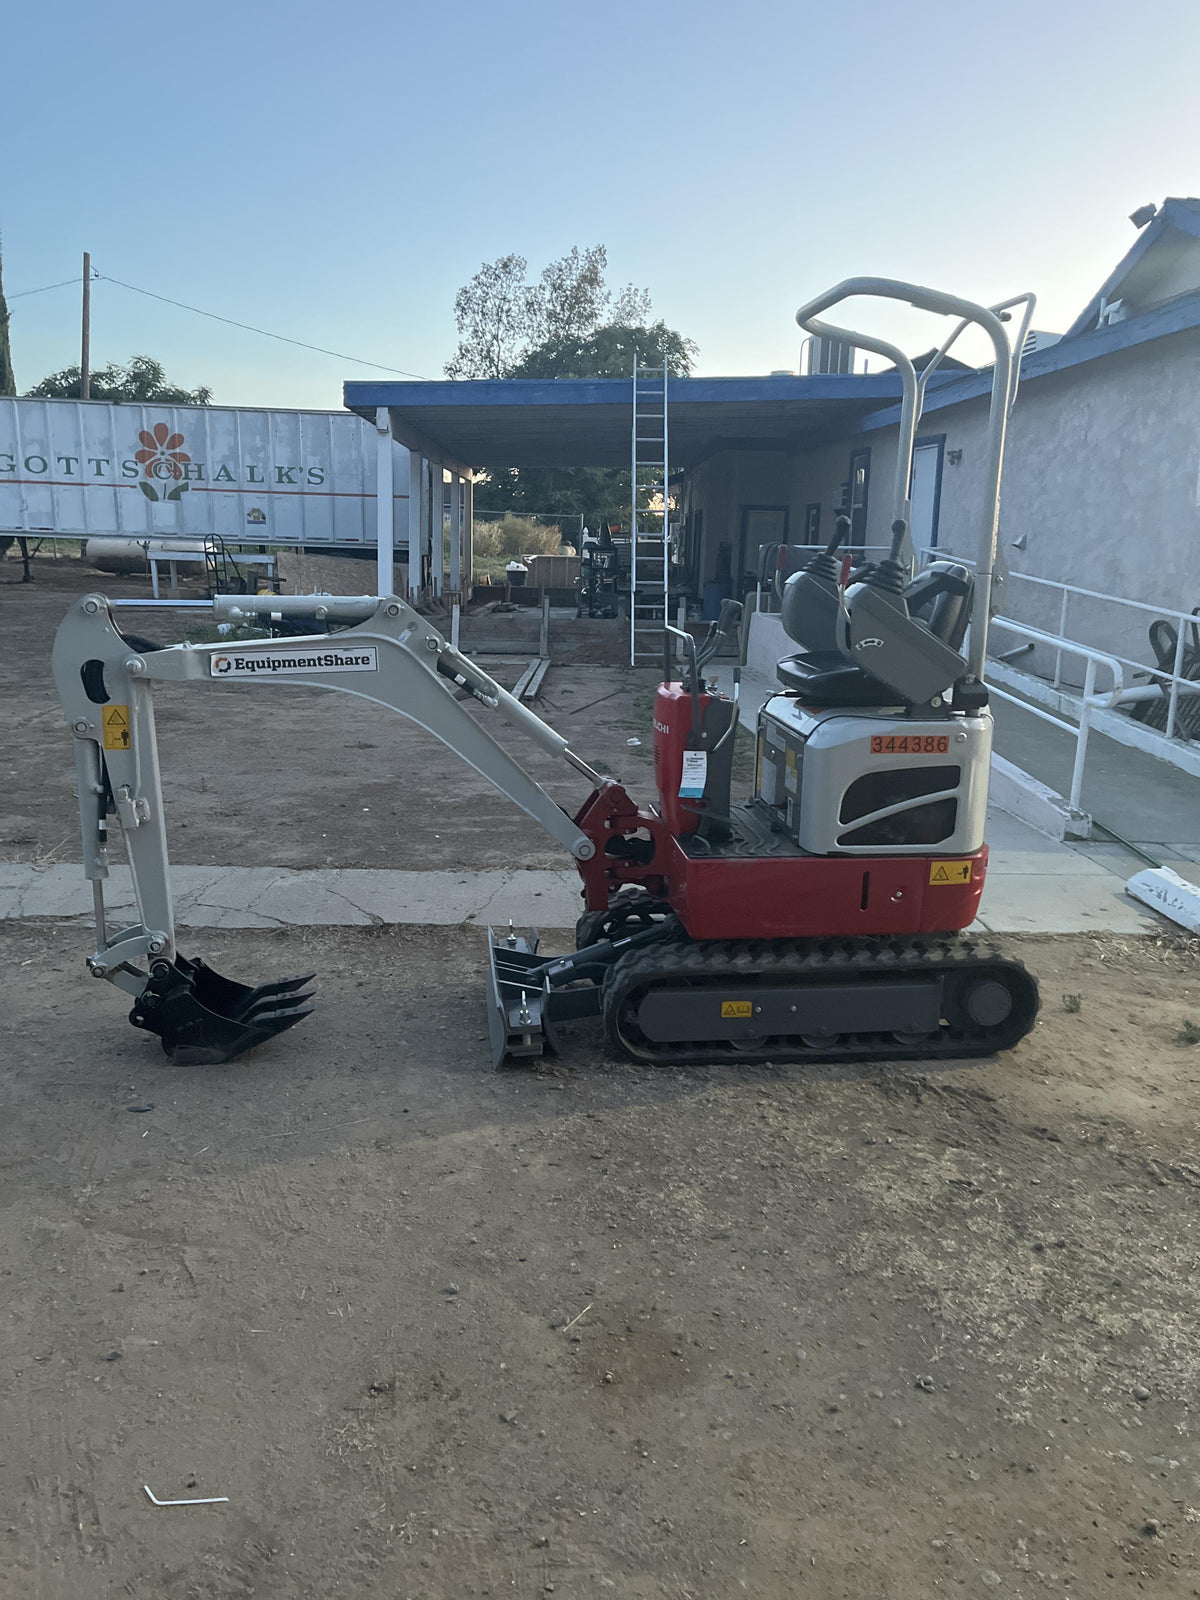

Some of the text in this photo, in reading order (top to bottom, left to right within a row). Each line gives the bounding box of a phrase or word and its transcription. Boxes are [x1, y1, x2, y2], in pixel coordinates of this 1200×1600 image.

[0, 454, 324, 485] GOTTSCHALK'S
[234, 655, 370, 672] EquipmentShare
[872, 736, 948, 753] 344386
